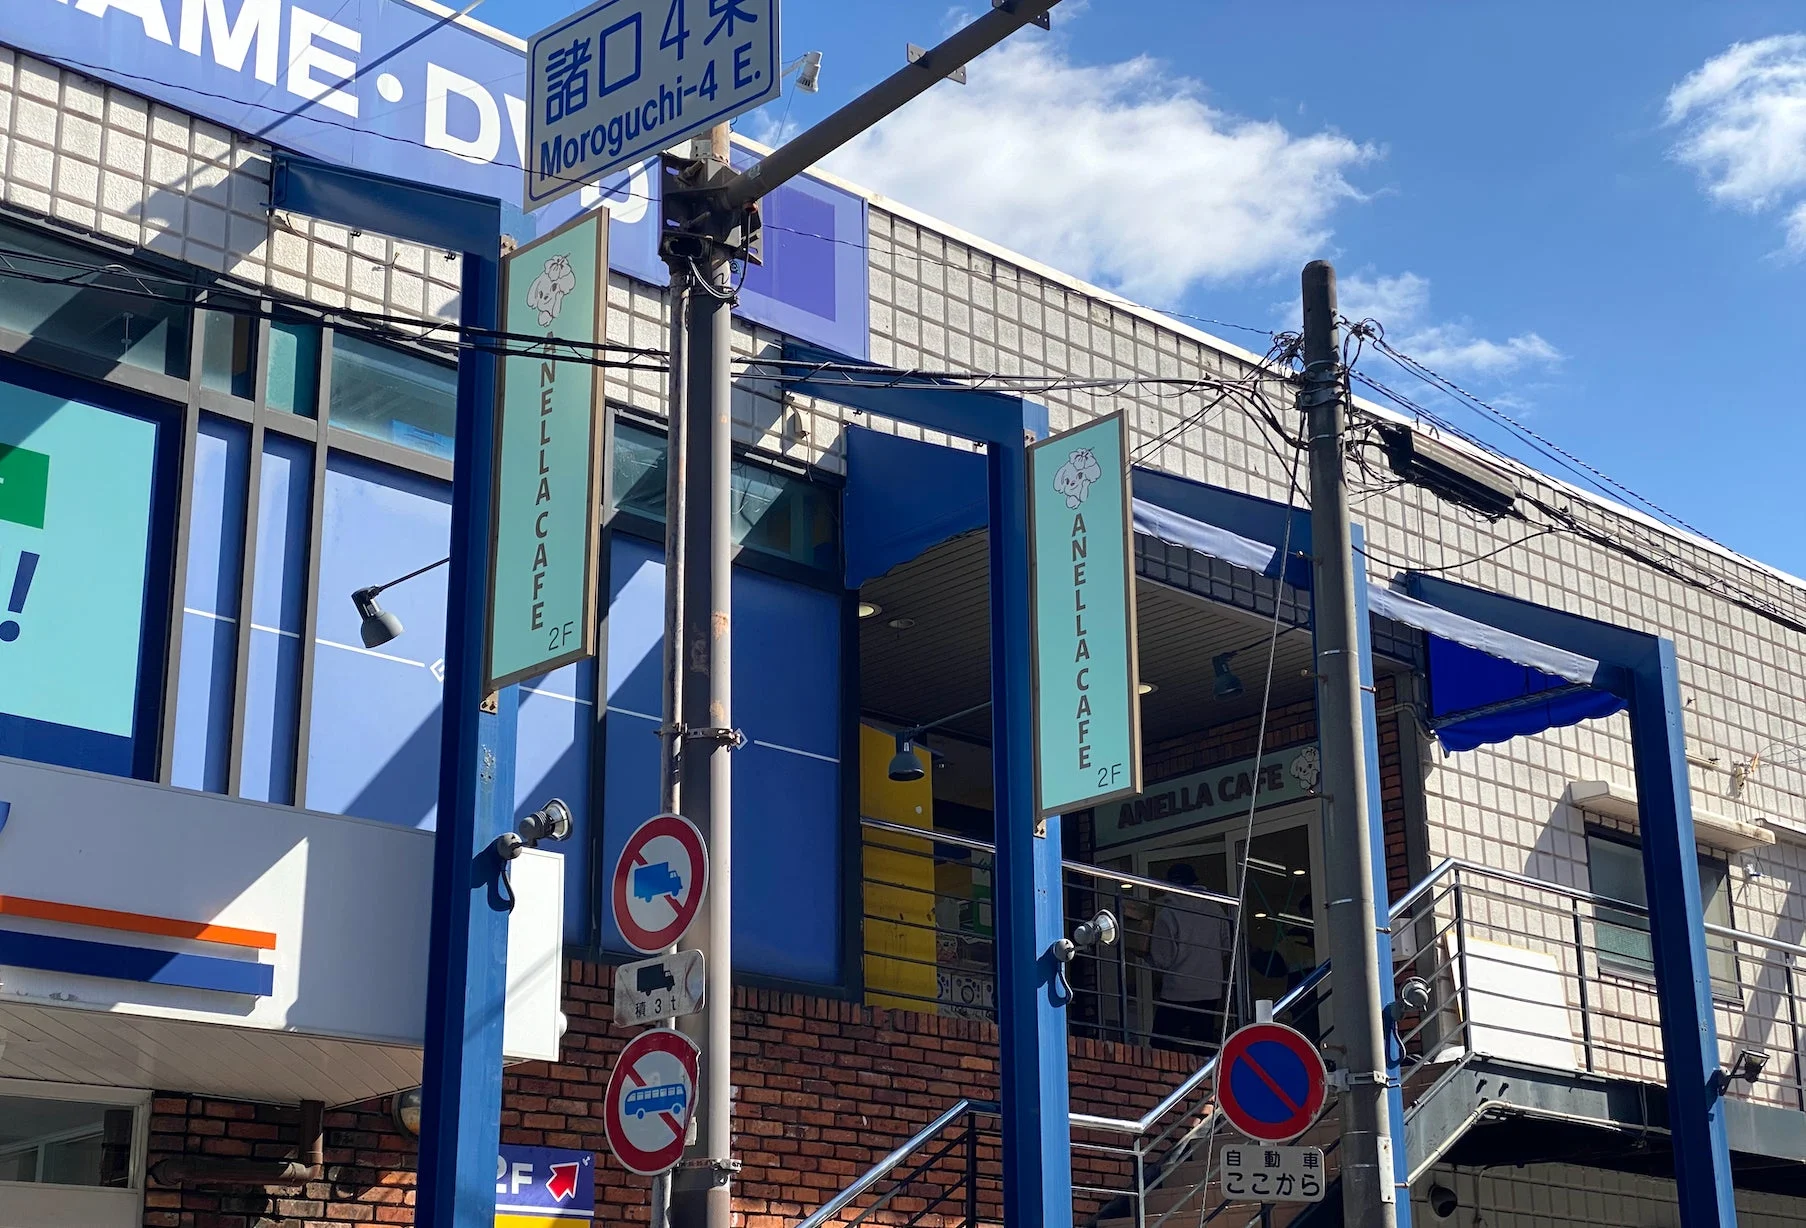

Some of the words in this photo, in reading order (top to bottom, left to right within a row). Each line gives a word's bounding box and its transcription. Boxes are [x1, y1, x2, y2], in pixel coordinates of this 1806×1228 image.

[540, 59, 718, 182] Moroguchi-4
[734, 41, 761, 90] E.
[531, 511, 549, 631] CAFE
[1071, 513, 1090, 663] ANELLA
[548, 621, 574, 651] 2F
[1076, 667, 1092, 770] CAFE
[1098, 763, 1122, 788] 2F
[1117, 782, 1214, 830] ANELLA
[1217, 763, 1284, 803] CAFE
[1227, 1150, 1319, 1169] 自動車
[1227, 1172, 1320, 1197] ここから
